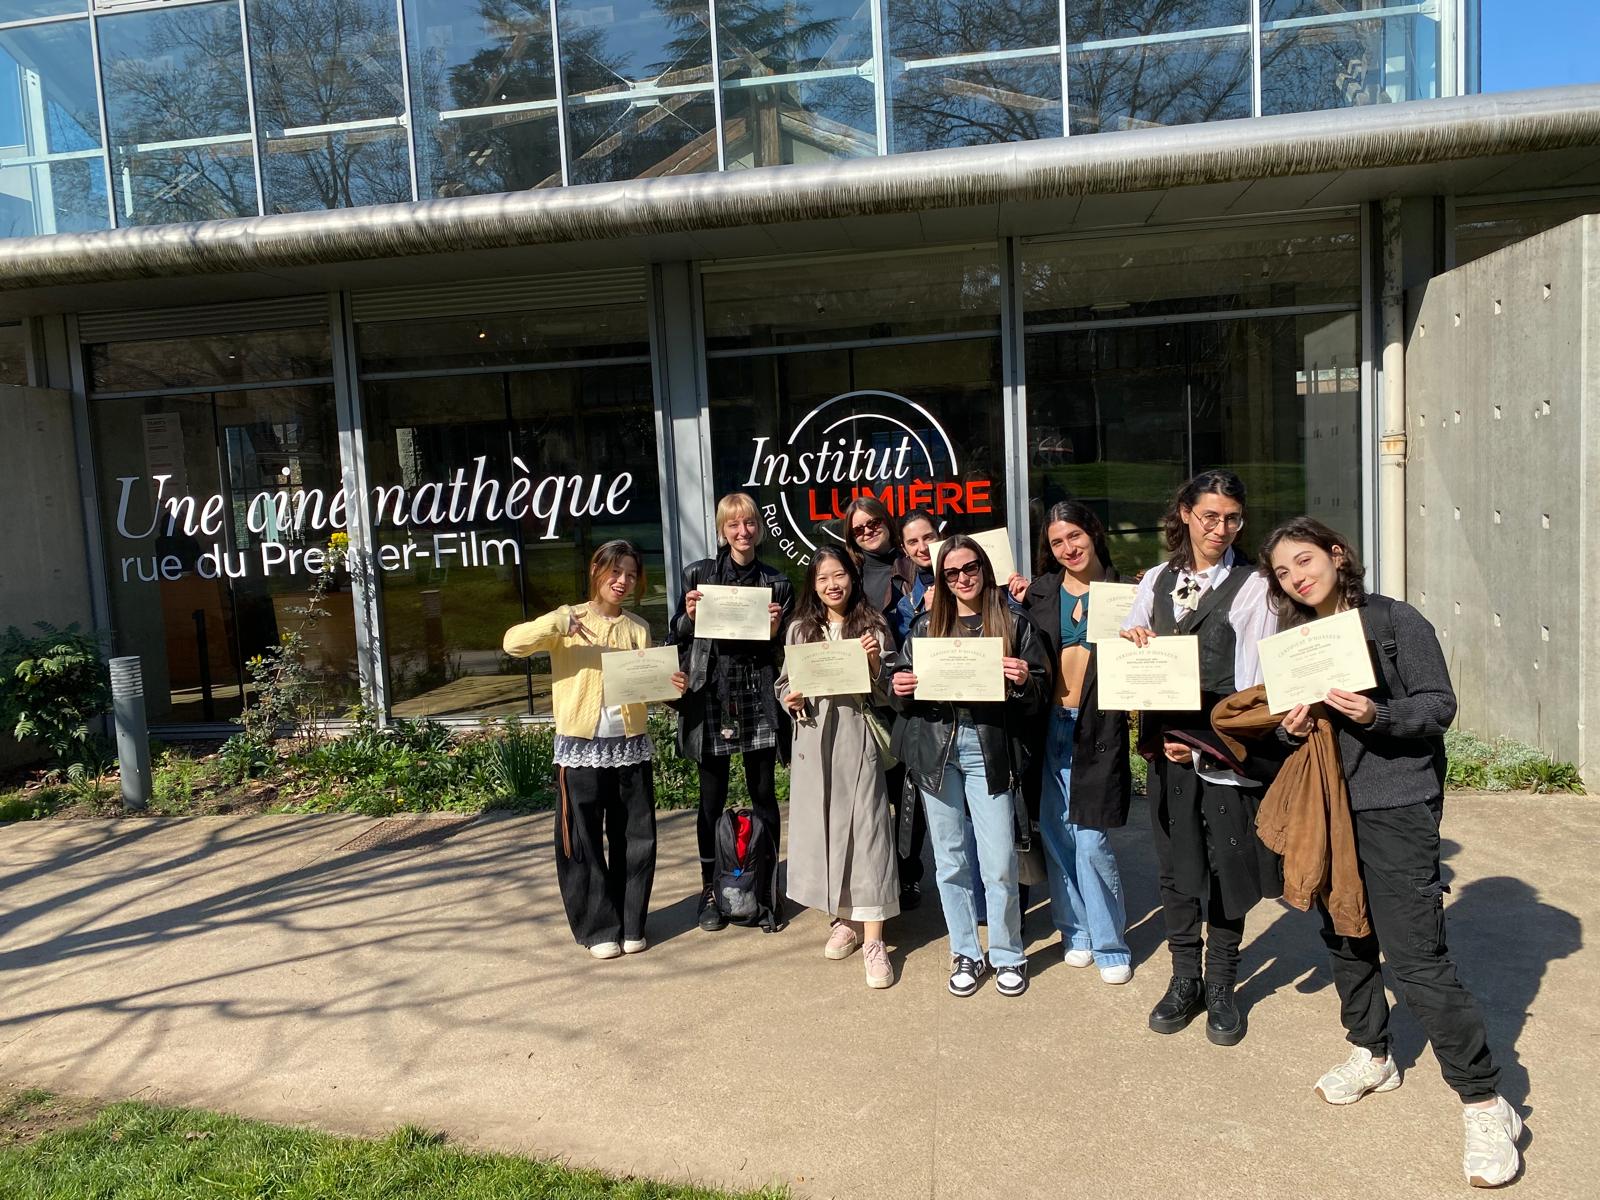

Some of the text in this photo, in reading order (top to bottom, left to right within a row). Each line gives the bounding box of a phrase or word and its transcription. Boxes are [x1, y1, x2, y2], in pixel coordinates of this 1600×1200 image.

[742, 437, 911, 487] Institut
[116, 455, 632, 540] Une cinémathèque
[808, 479, 992, 521] LUMIÈRE
[762, 503, 799, 560] Rue du
[121, 553, 182, 582] rue
[196, 544, 247, 579] du
